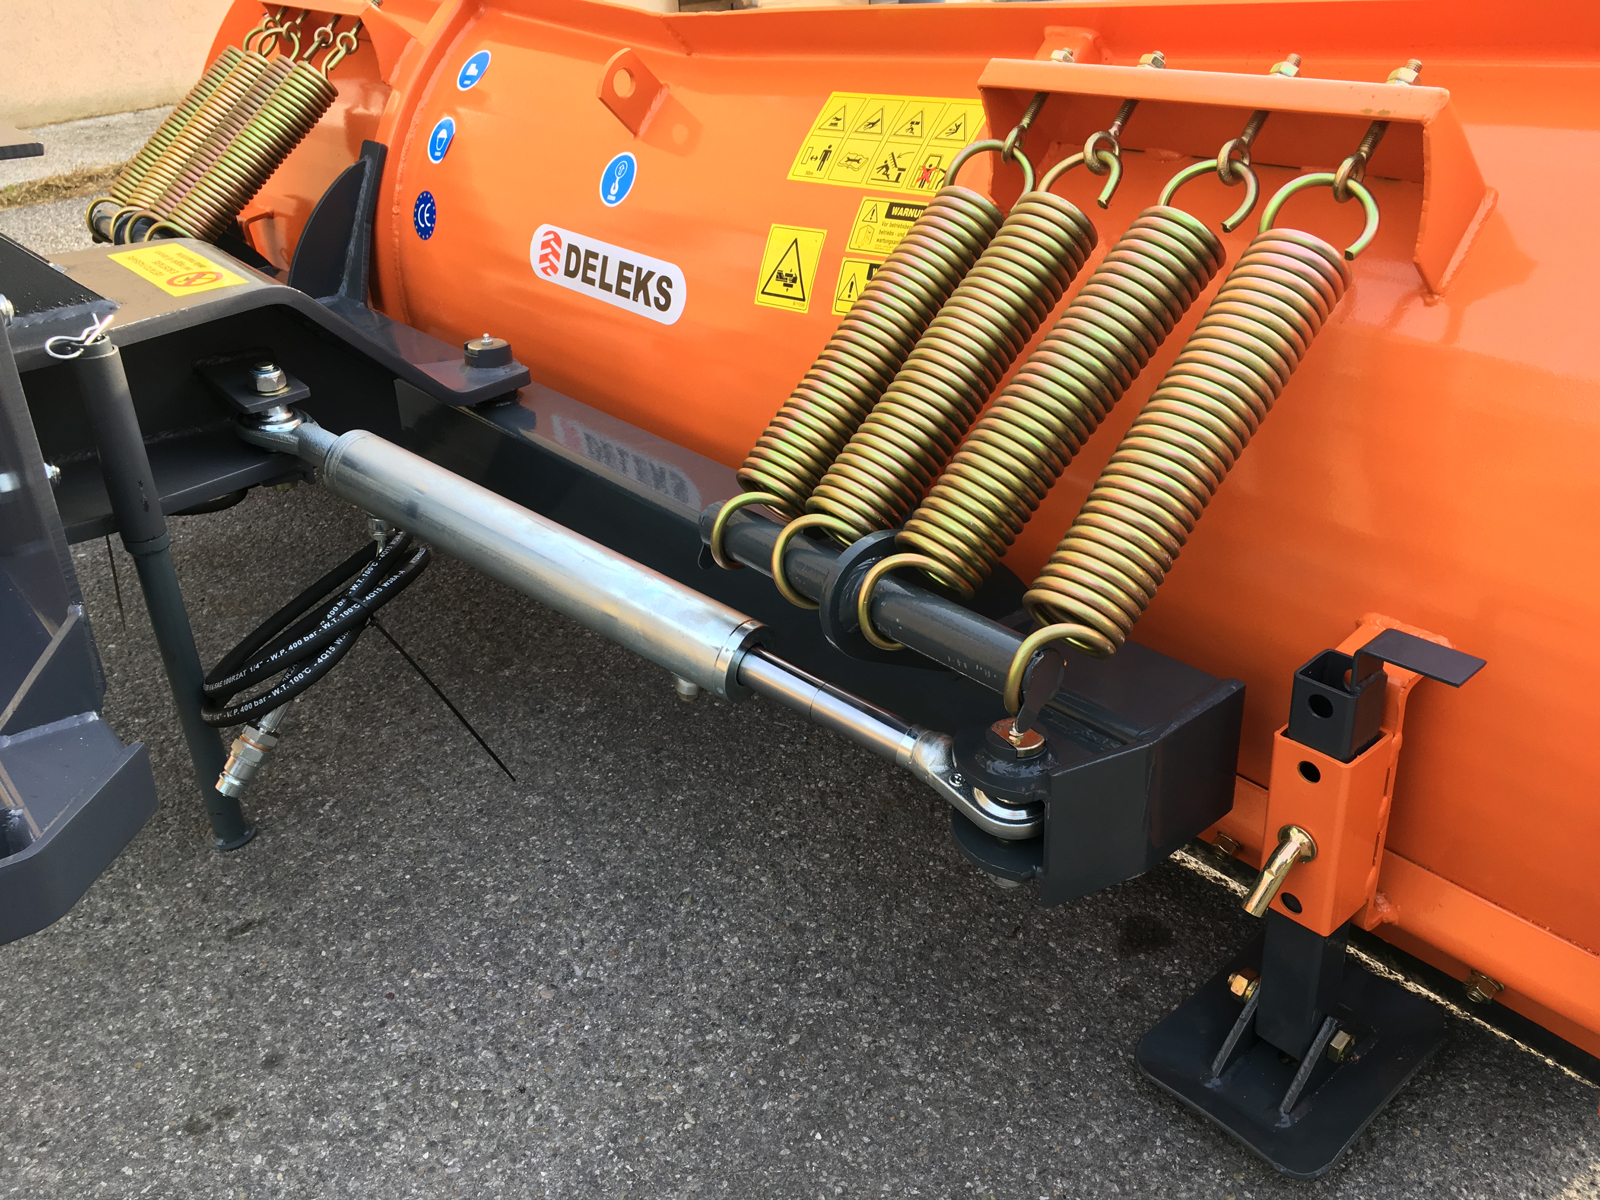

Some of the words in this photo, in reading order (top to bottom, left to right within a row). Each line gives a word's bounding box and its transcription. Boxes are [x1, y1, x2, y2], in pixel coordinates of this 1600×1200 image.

[418, 202, 431, 228] CE
[564, 242, 673, 312] DELEKS
[327, 606, 339, 619] 400
[270, 648, 288, 661] W.P.
[288, 639, 303, 651] 400
[303, 631, 317, 642] bar
[322, 618, 339, 629] W.T.
[240, 702, 253, 713] 400
[253, 696, 266, 707] bar
[271, 684, 289, 696] W.T.
